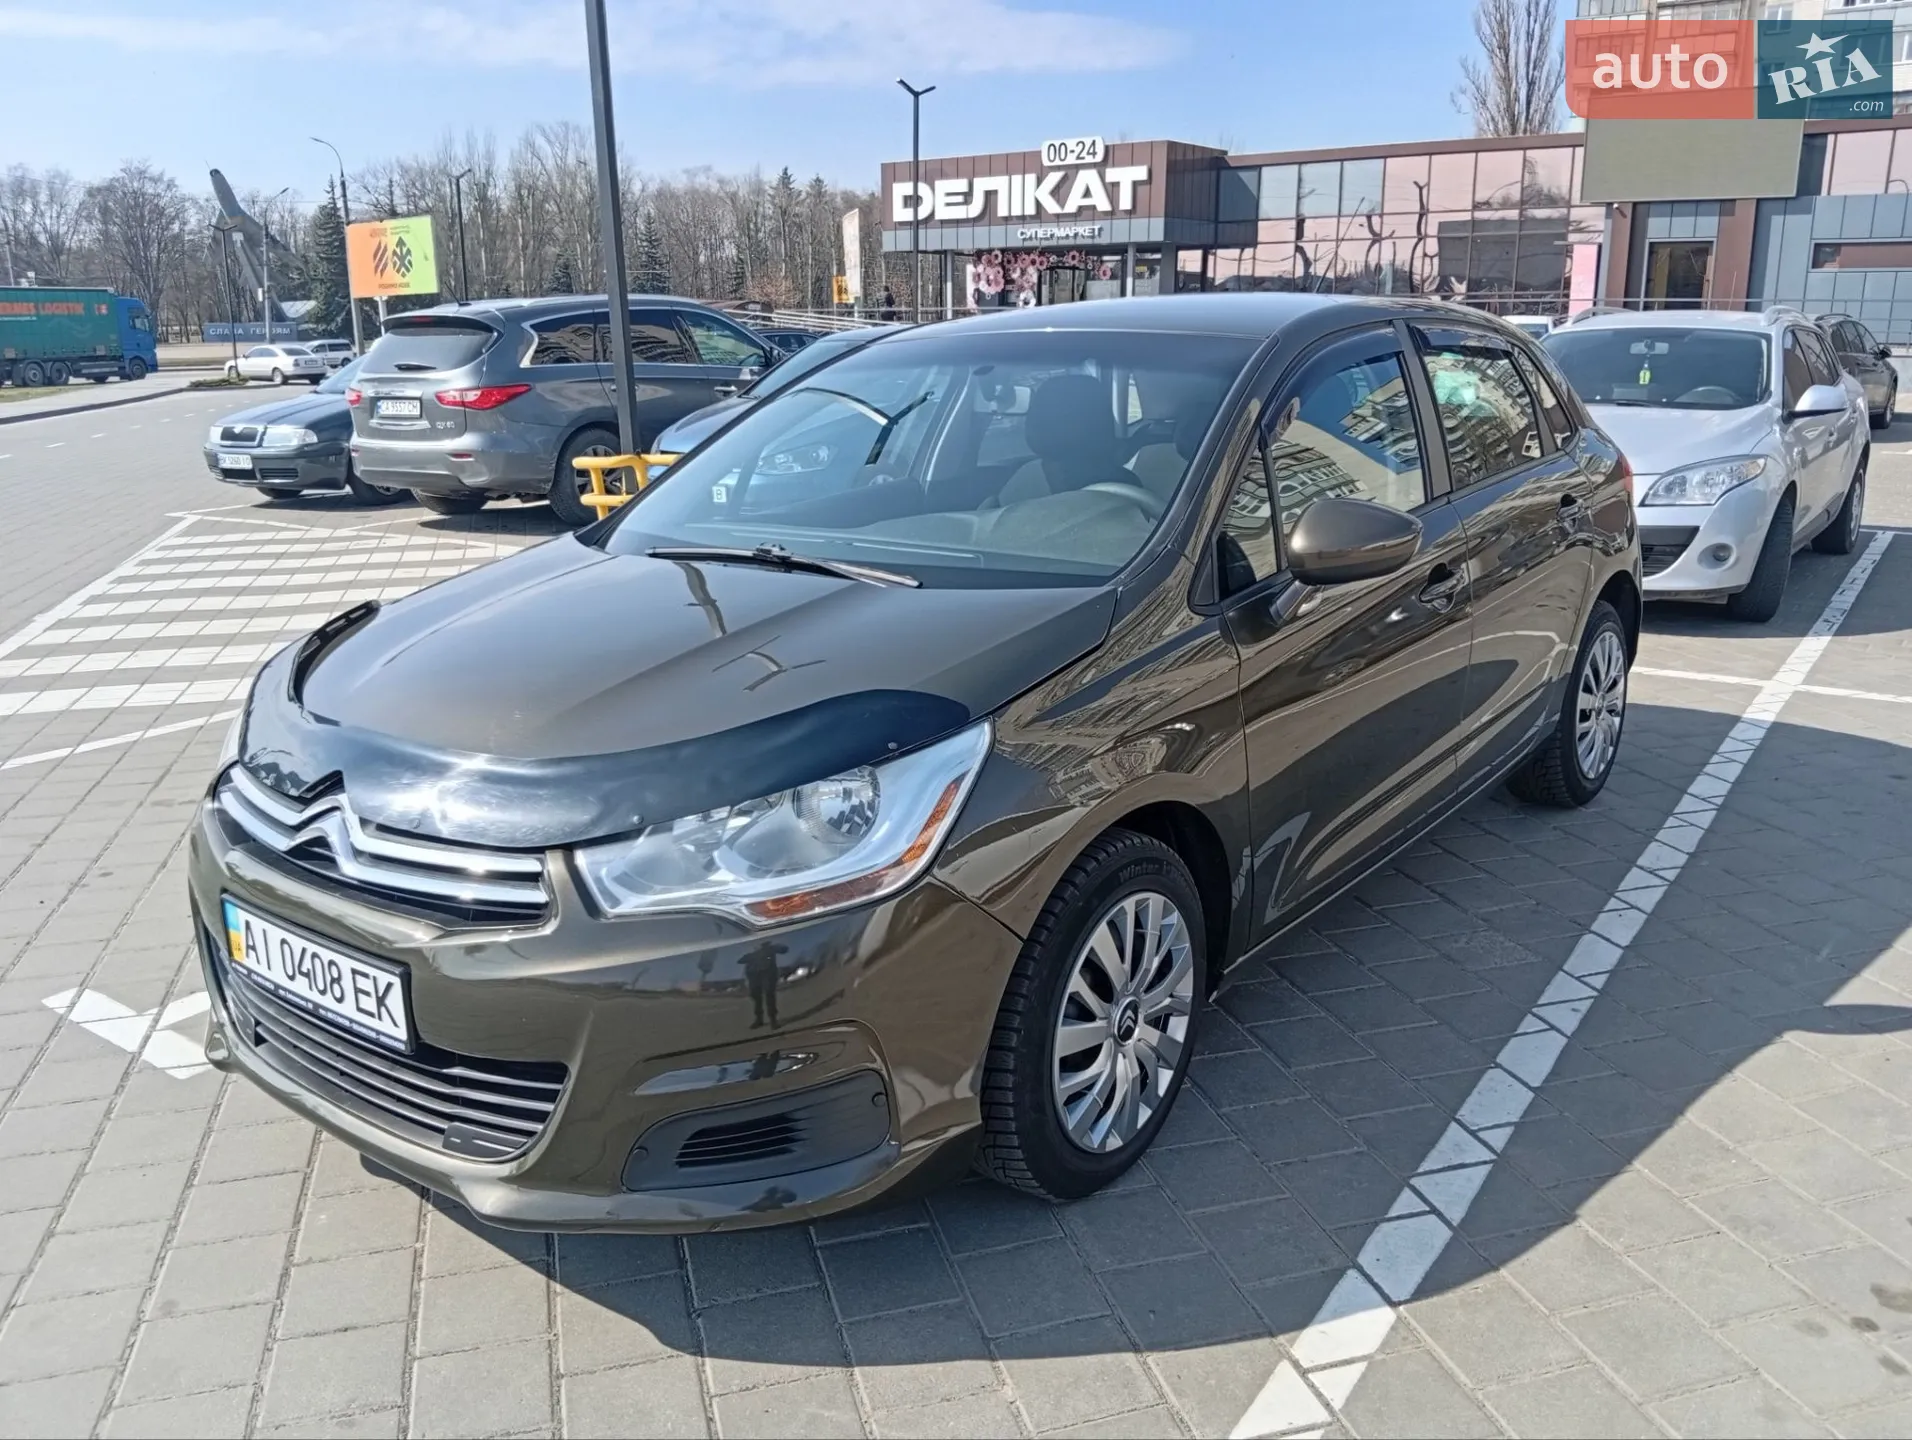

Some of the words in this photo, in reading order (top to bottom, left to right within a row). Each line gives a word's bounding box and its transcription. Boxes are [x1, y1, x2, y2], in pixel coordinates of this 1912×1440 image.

[1047, 139, 1097, 163] 00-24
[1017, 225, 1102, 239] СУПЕРМАРКЕТ
[245, 919, 272, 972] AI
[280, 937, 346, 1004] 0408
[350, 967, 400, 1029] EK
